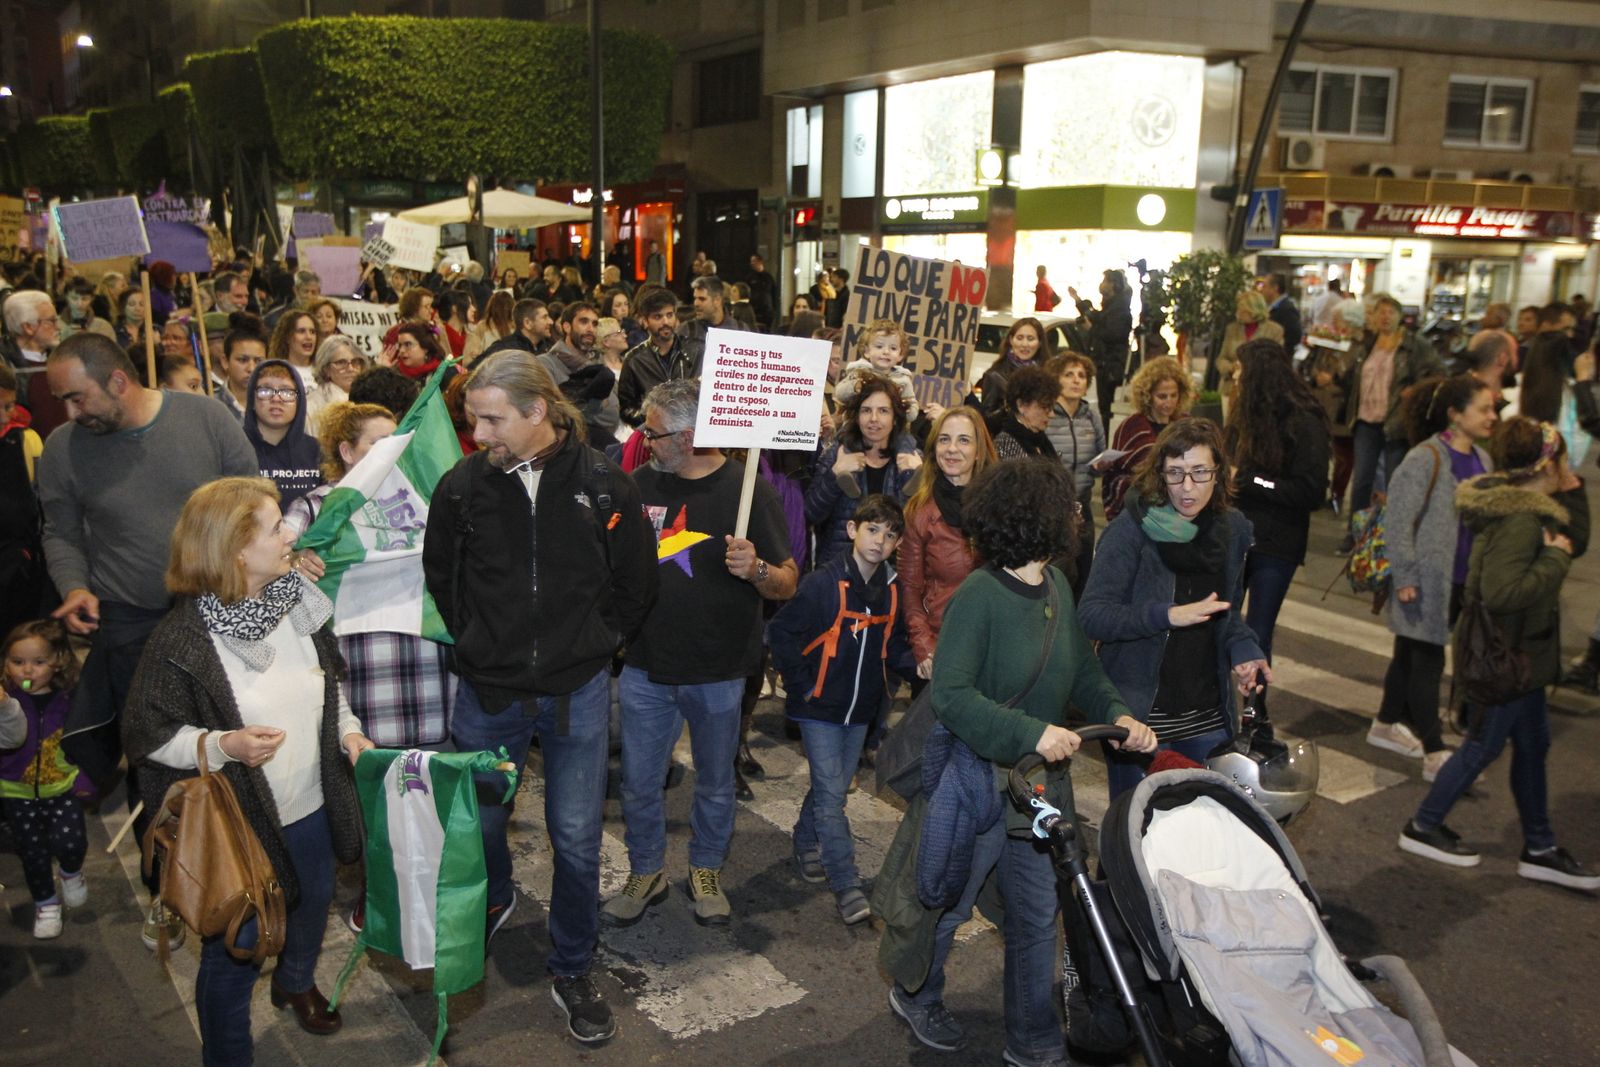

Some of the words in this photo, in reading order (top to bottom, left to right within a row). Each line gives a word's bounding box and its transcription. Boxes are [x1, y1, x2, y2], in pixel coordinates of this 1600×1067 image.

[144, 197, 187, 211] CONTRA
[1374, 204, 1463, 223] Parrilla
[1466, 207, 1538, 229] Pasaje
[857, 248, 890, 288] LO
[894, 256, 944, 299] QUE
[948, 265, 986, 305] NO
[378, 312, 391, 325] NI
[854, 285, 921, 333] TUVE
[924, 298, 978, 345] PARA
[719, 344, 731, 354] Te
[733, 347, 758, 357] casas
[761, 350, 766, 359] y
[769, 350, 782, 359] tus
[716, 358, 758, 369] derechos
[761, 361, 801, 373] humanos
[923, 339, 966, 380] SEA
[715, 370, 745, 380] civiles
[761, 373, 814, 385] desaparecen
[714, 381, 744, 391] dentro
[747, 384, 757, 392] de
[760, 384, 772, 394] los
[774, 385, 812, 397] derechos
[712, 393, 723, 402] de
[739, 396, 770, 406] esposo,
[711, 405, 770, 417] agradéceselo
[709, 416, 754, 428] feminista.
[778, 430, 816, 438] #NadaNosPara
